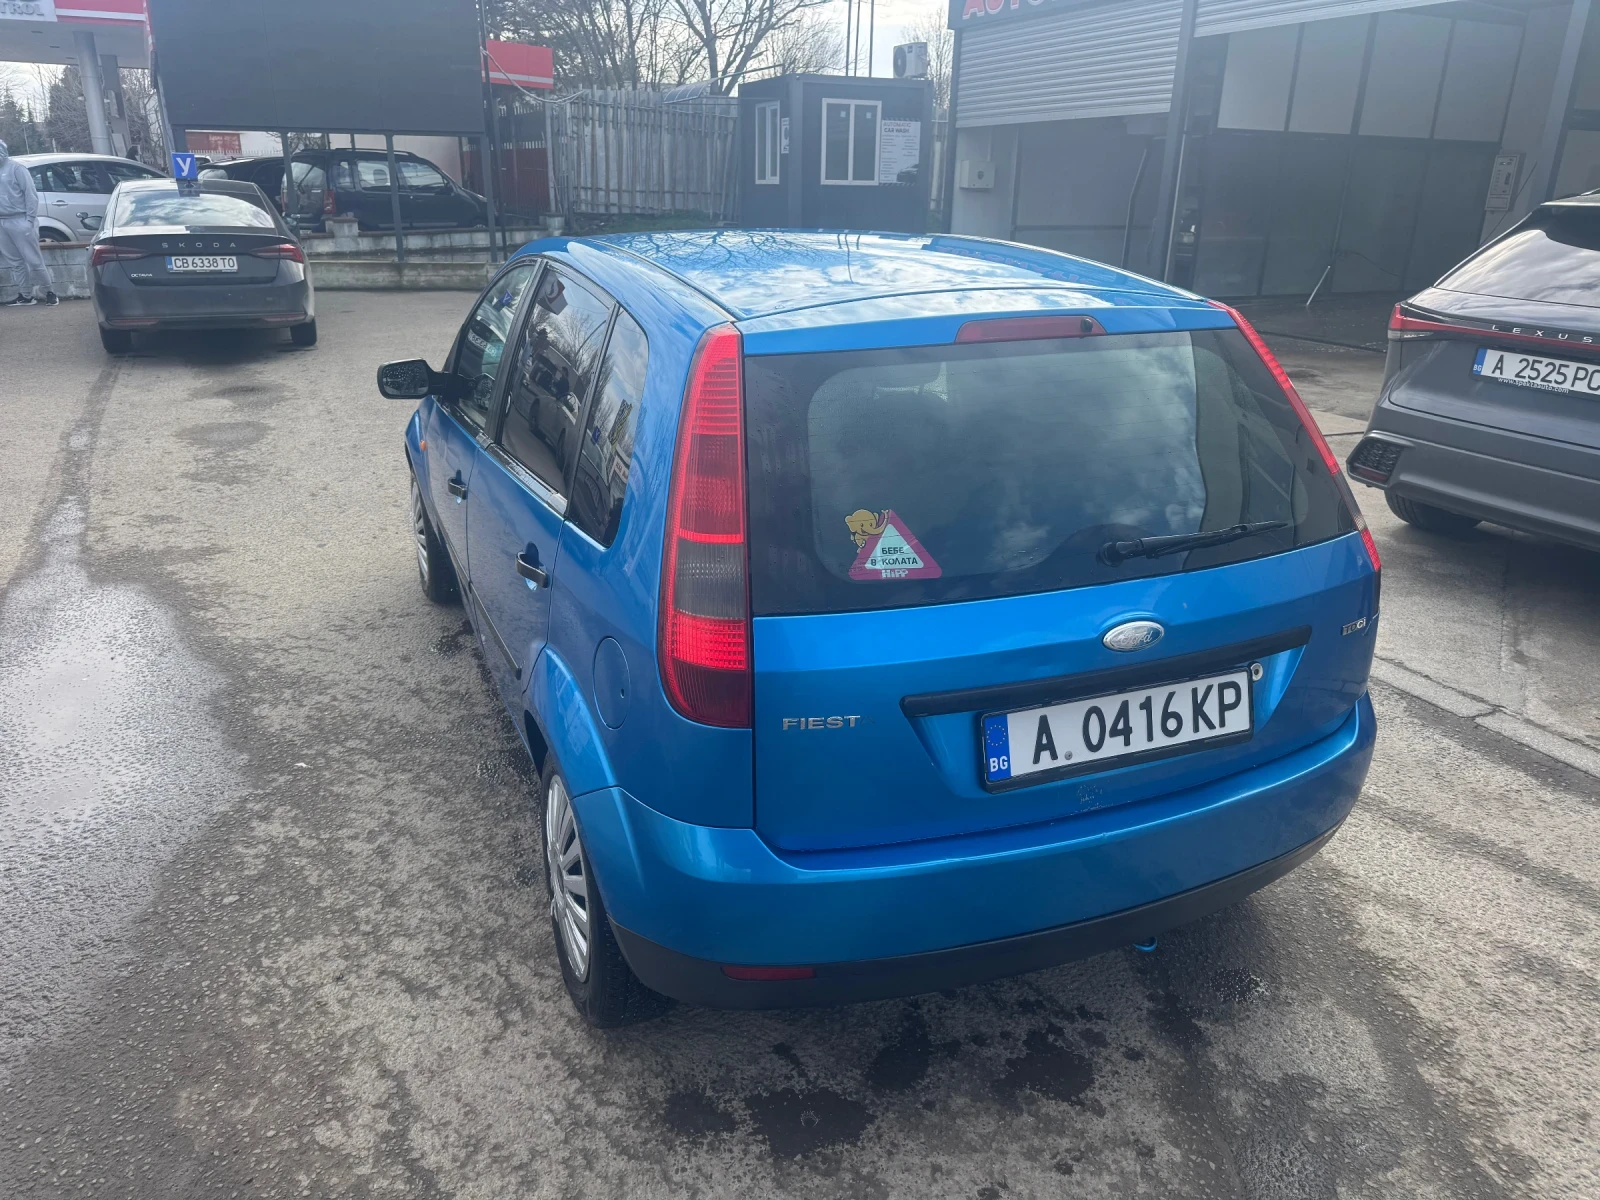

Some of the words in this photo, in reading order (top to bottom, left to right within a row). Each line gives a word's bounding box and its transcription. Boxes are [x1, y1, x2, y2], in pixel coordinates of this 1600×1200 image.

[174, 258, 190, 269] CB
[191, 257, 219, 269] 6338
[1492, 324, 1593, 343] LEXUS
[1473, 364, 1482, 372] BG
[1491, 354, 1505, 376] A
[1514, 358, 1570, 385] 2525
[881, 546, 905, 555] БЕБЕ
[870, 558, 877, 566] В
[881, 557, 919, 566] КОЛАТА
[1112, 626, 1156, 648] Ford
[1082, 691, 1184, 753] 0416
[1191, 680, 1242, 734] KP
[989, 755, 1009, 773] BG
